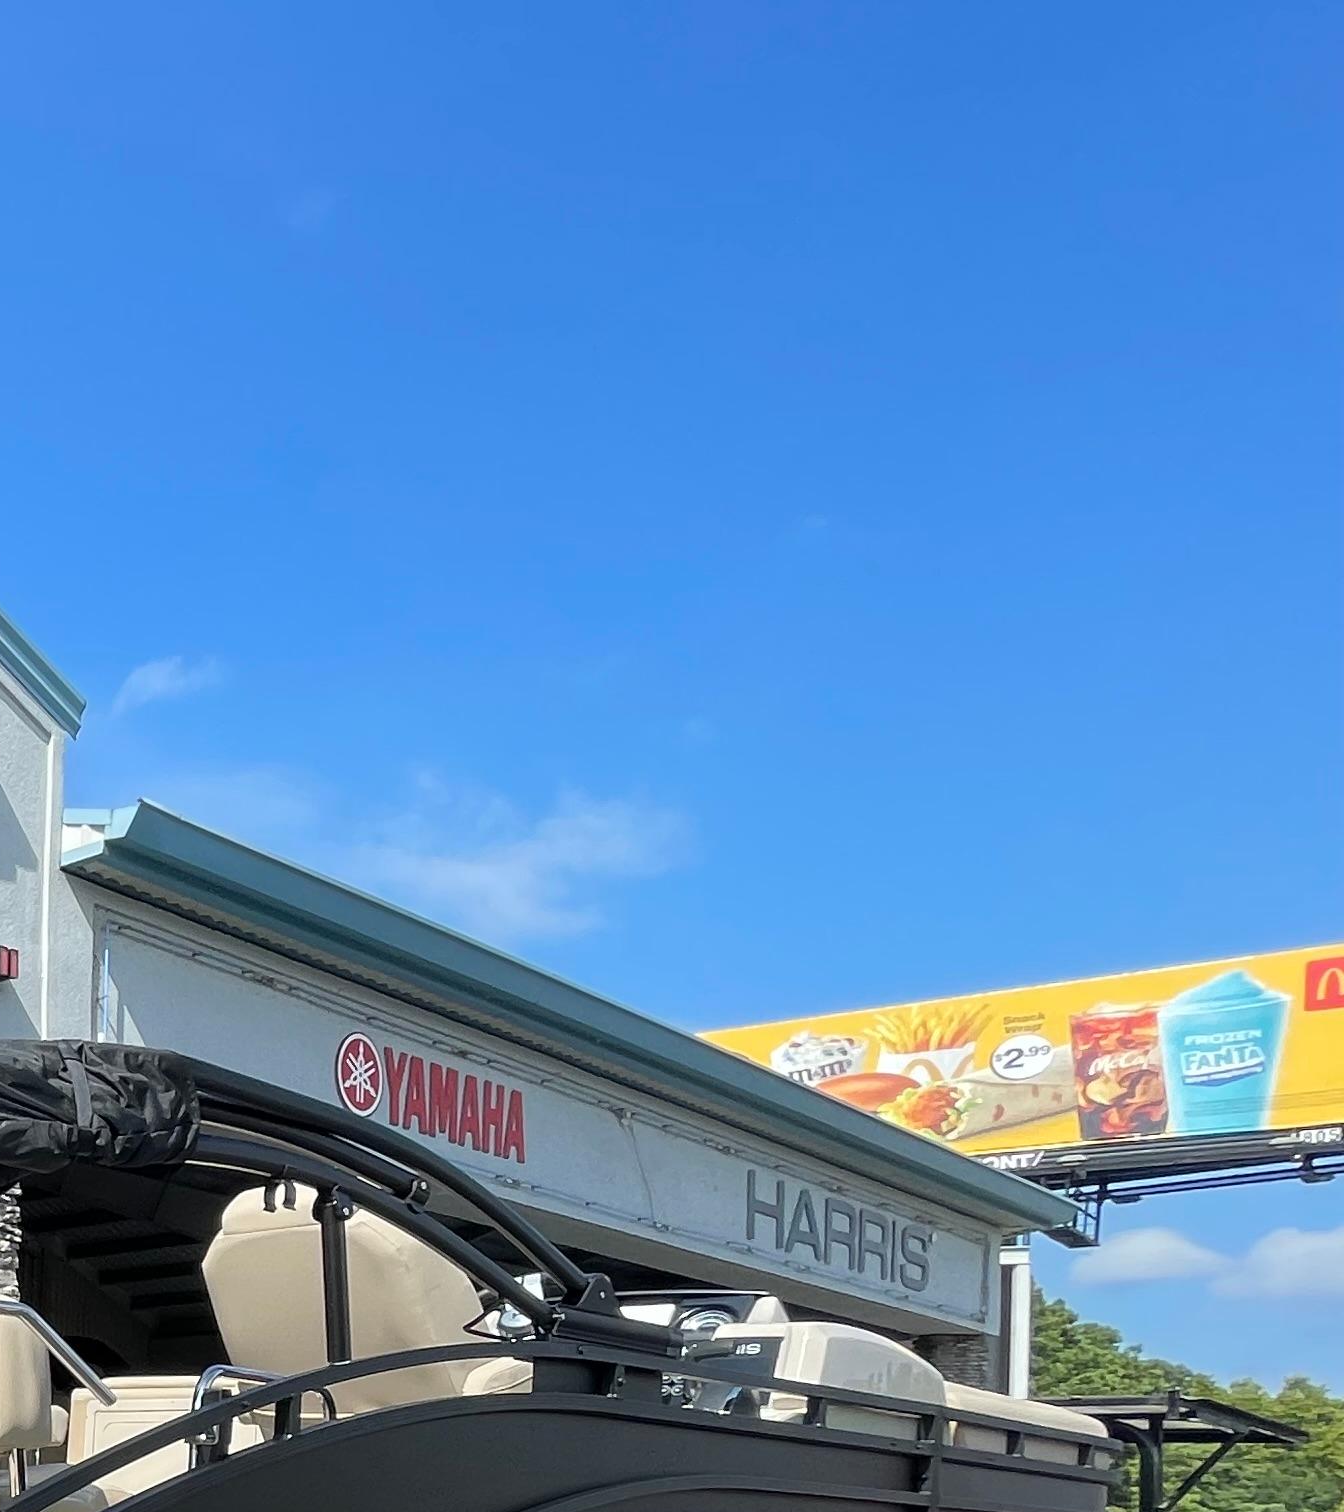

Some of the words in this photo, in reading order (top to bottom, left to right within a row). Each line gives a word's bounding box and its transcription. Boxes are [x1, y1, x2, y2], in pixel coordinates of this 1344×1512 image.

[1182, 1045, 1263, 1071] FANTA
[1184, 1029, 1263, 1046] FROZEN
[384, 1047, 525, 1164] YAMAHA
[746, 1169, 930, 1292] HARRIS
